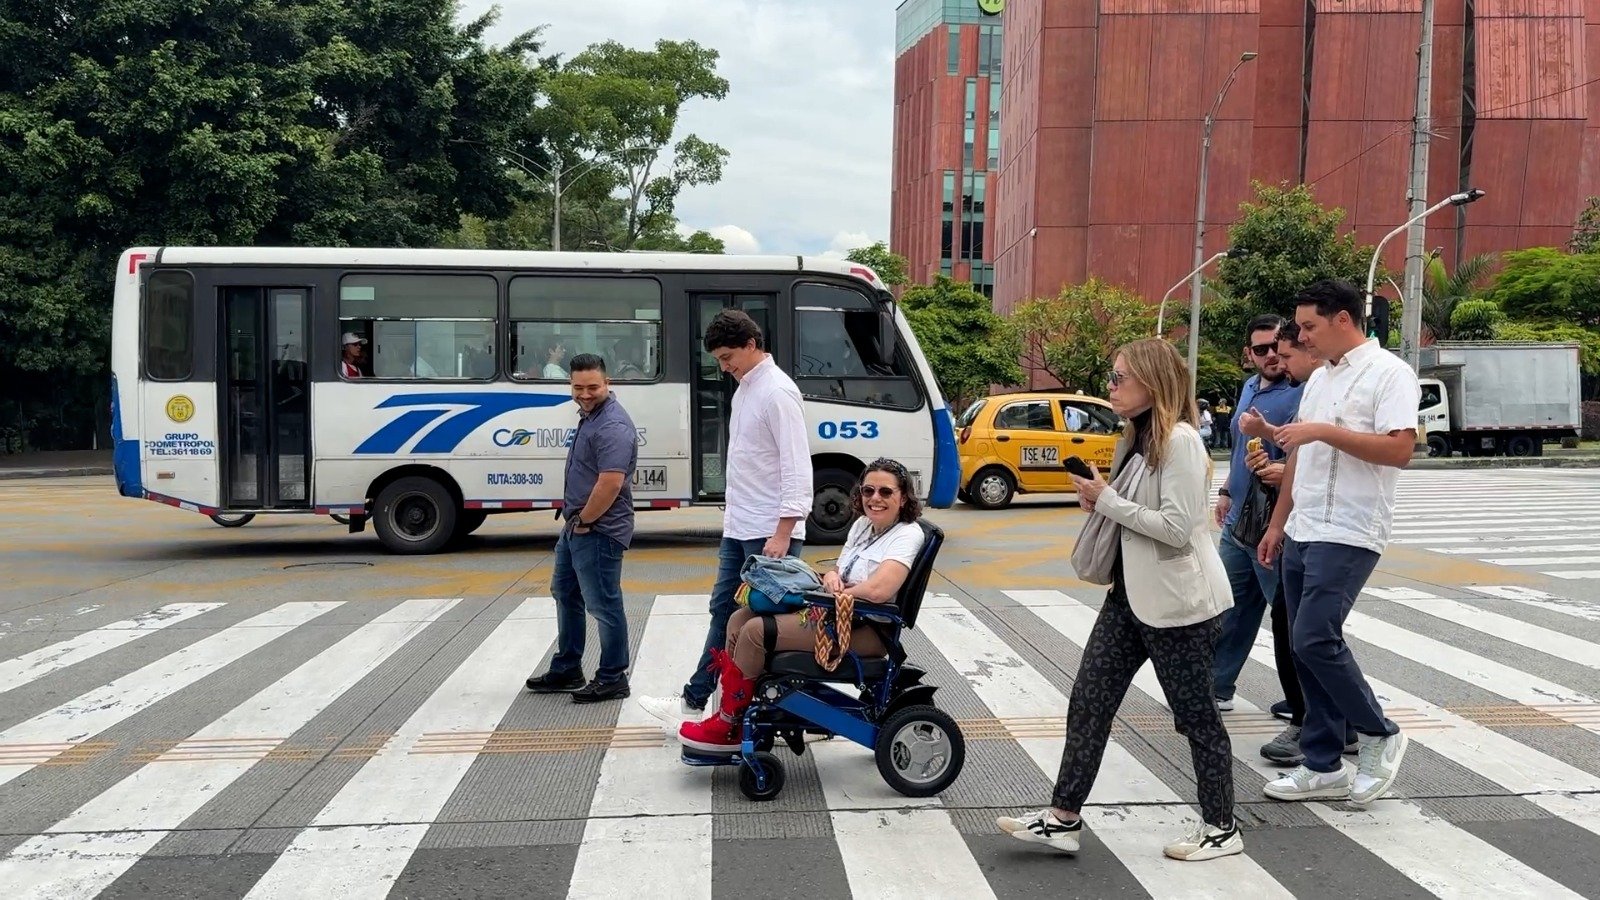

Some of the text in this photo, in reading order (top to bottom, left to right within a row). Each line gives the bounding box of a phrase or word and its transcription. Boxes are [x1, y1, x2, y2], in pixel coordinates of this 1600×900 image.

[818, 421, 879, 439] 053
[1023, 448, 1057, 461] TSE 422
[487, 473, 543, 485] RUTA:308-309
